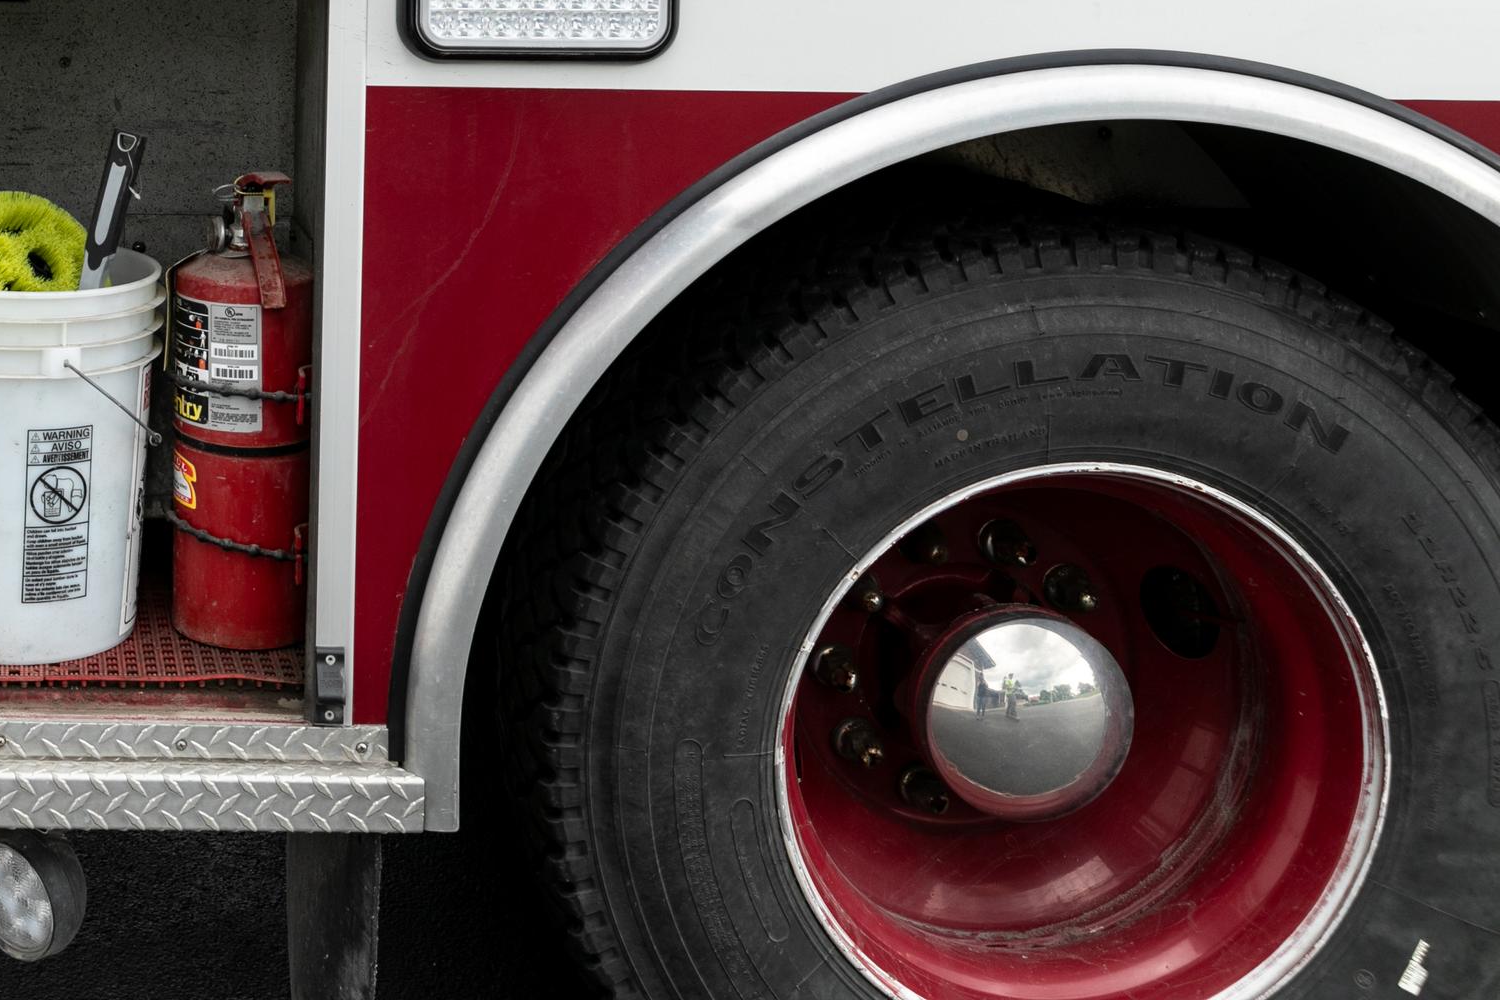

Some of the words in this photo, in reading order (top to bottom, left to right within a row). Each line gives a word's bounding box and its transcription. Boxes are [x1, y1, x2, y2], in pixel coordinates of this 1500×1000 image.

[43, 428, 90, 440] WARNING
[51, 441, 82, 451] AVISO
[934, 449, 965, 468] MADE
[966, 443, 981, 455] IN
[985, 427, 1046, 447] THAILAND
[694, 353, 1351, 647] CONSTELLATION
